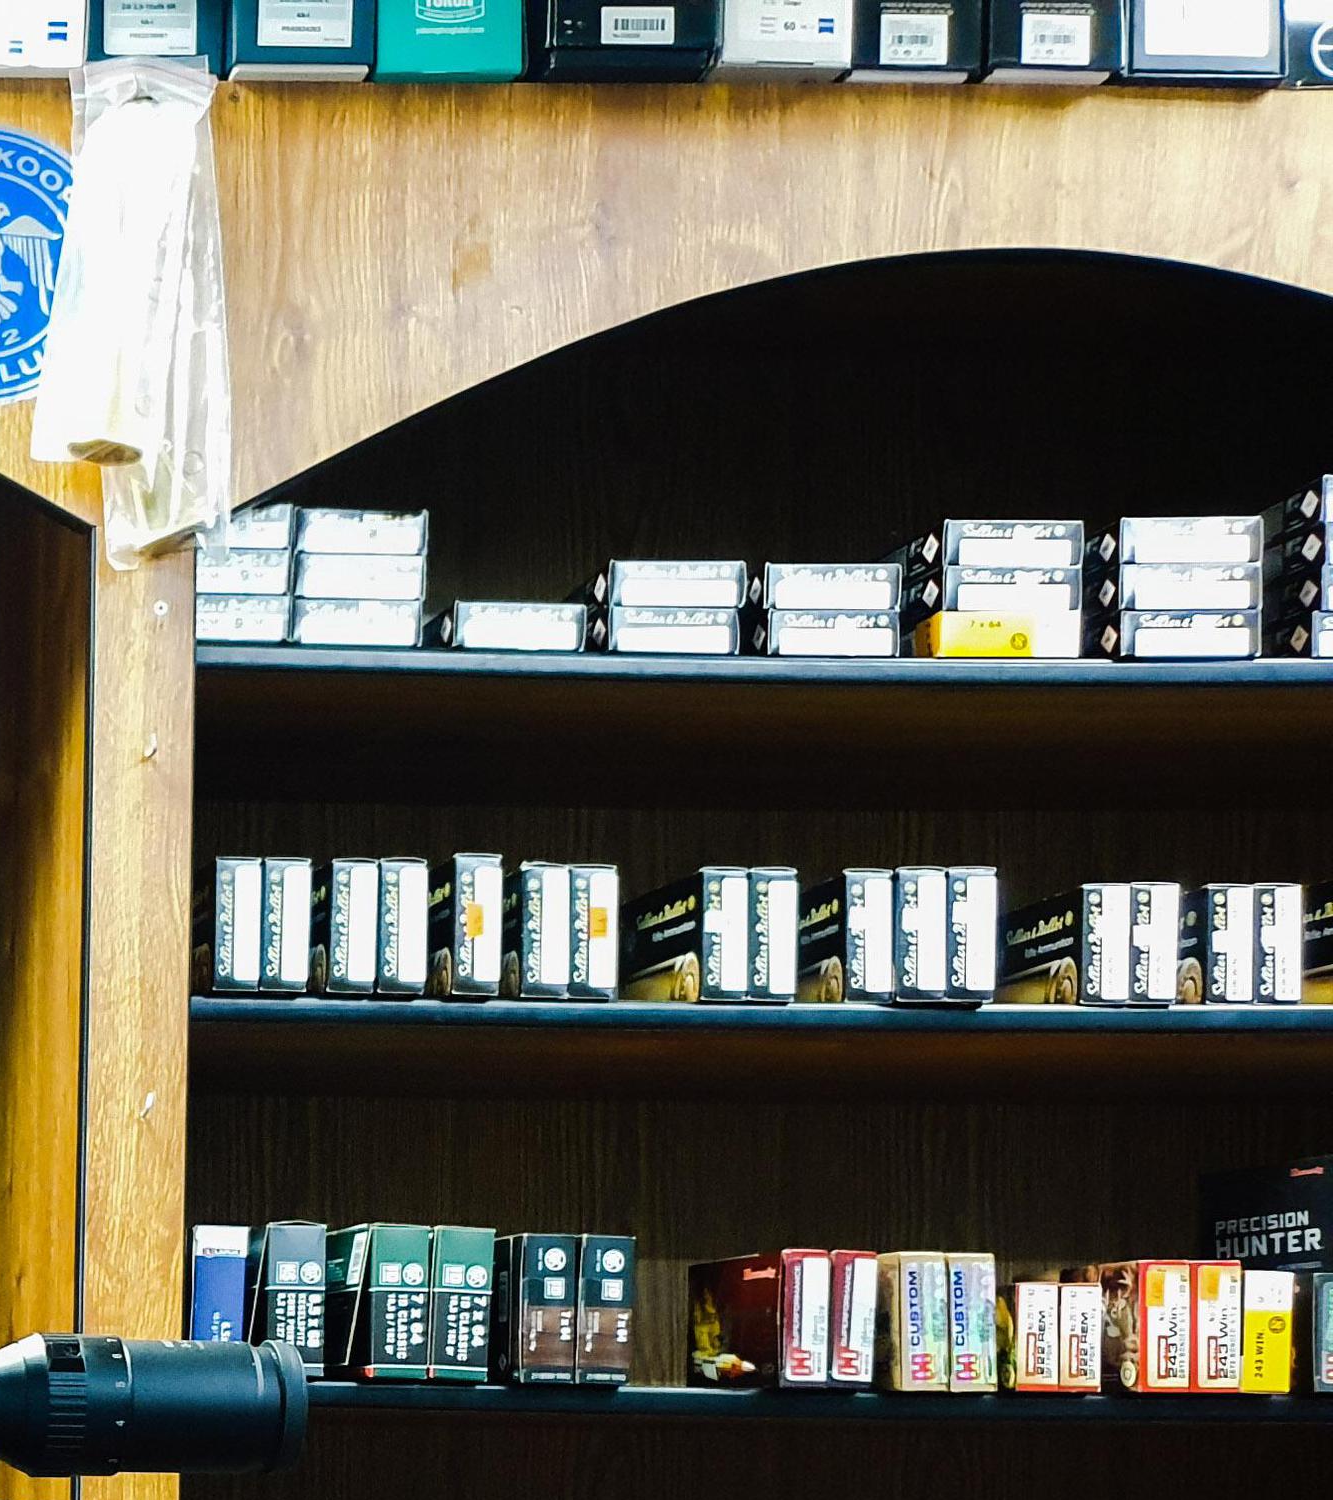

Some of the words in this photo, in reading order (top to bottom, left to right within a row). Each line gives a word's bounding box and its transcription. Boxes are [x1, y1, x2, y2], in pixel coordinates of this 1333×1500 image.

[1215, 1210, 1309, 1236] PRECISION
[1216, 1228, 1324, 1259] HUNTER
[410, 1293, 424, 1304] 7
[410, 1308, 422, 1319] x
[473, 1295, 487, 1307] 7
[908, 1270, 921, 1347] CUSTOM
[953, 1270, 965, 1347] CUSTOM
[472, 1310, 484, 1321] x
[1037, 1310, 1046, 1342] REM
[1079, 1311, 1089, 1344] REM
[396, 1309, 409, 1360] CLASSIC
[457, 1311, 470, 1362] CLASSIC
[1036, 1345, 1046, 1375] 222
[1079, 1347, 1089, 1377] 222
[1168, 1343, 1178, 1379] 243
[1219, 1343, 1229, 1379] 243
[1254, 1359, 1263, 1378] 243
